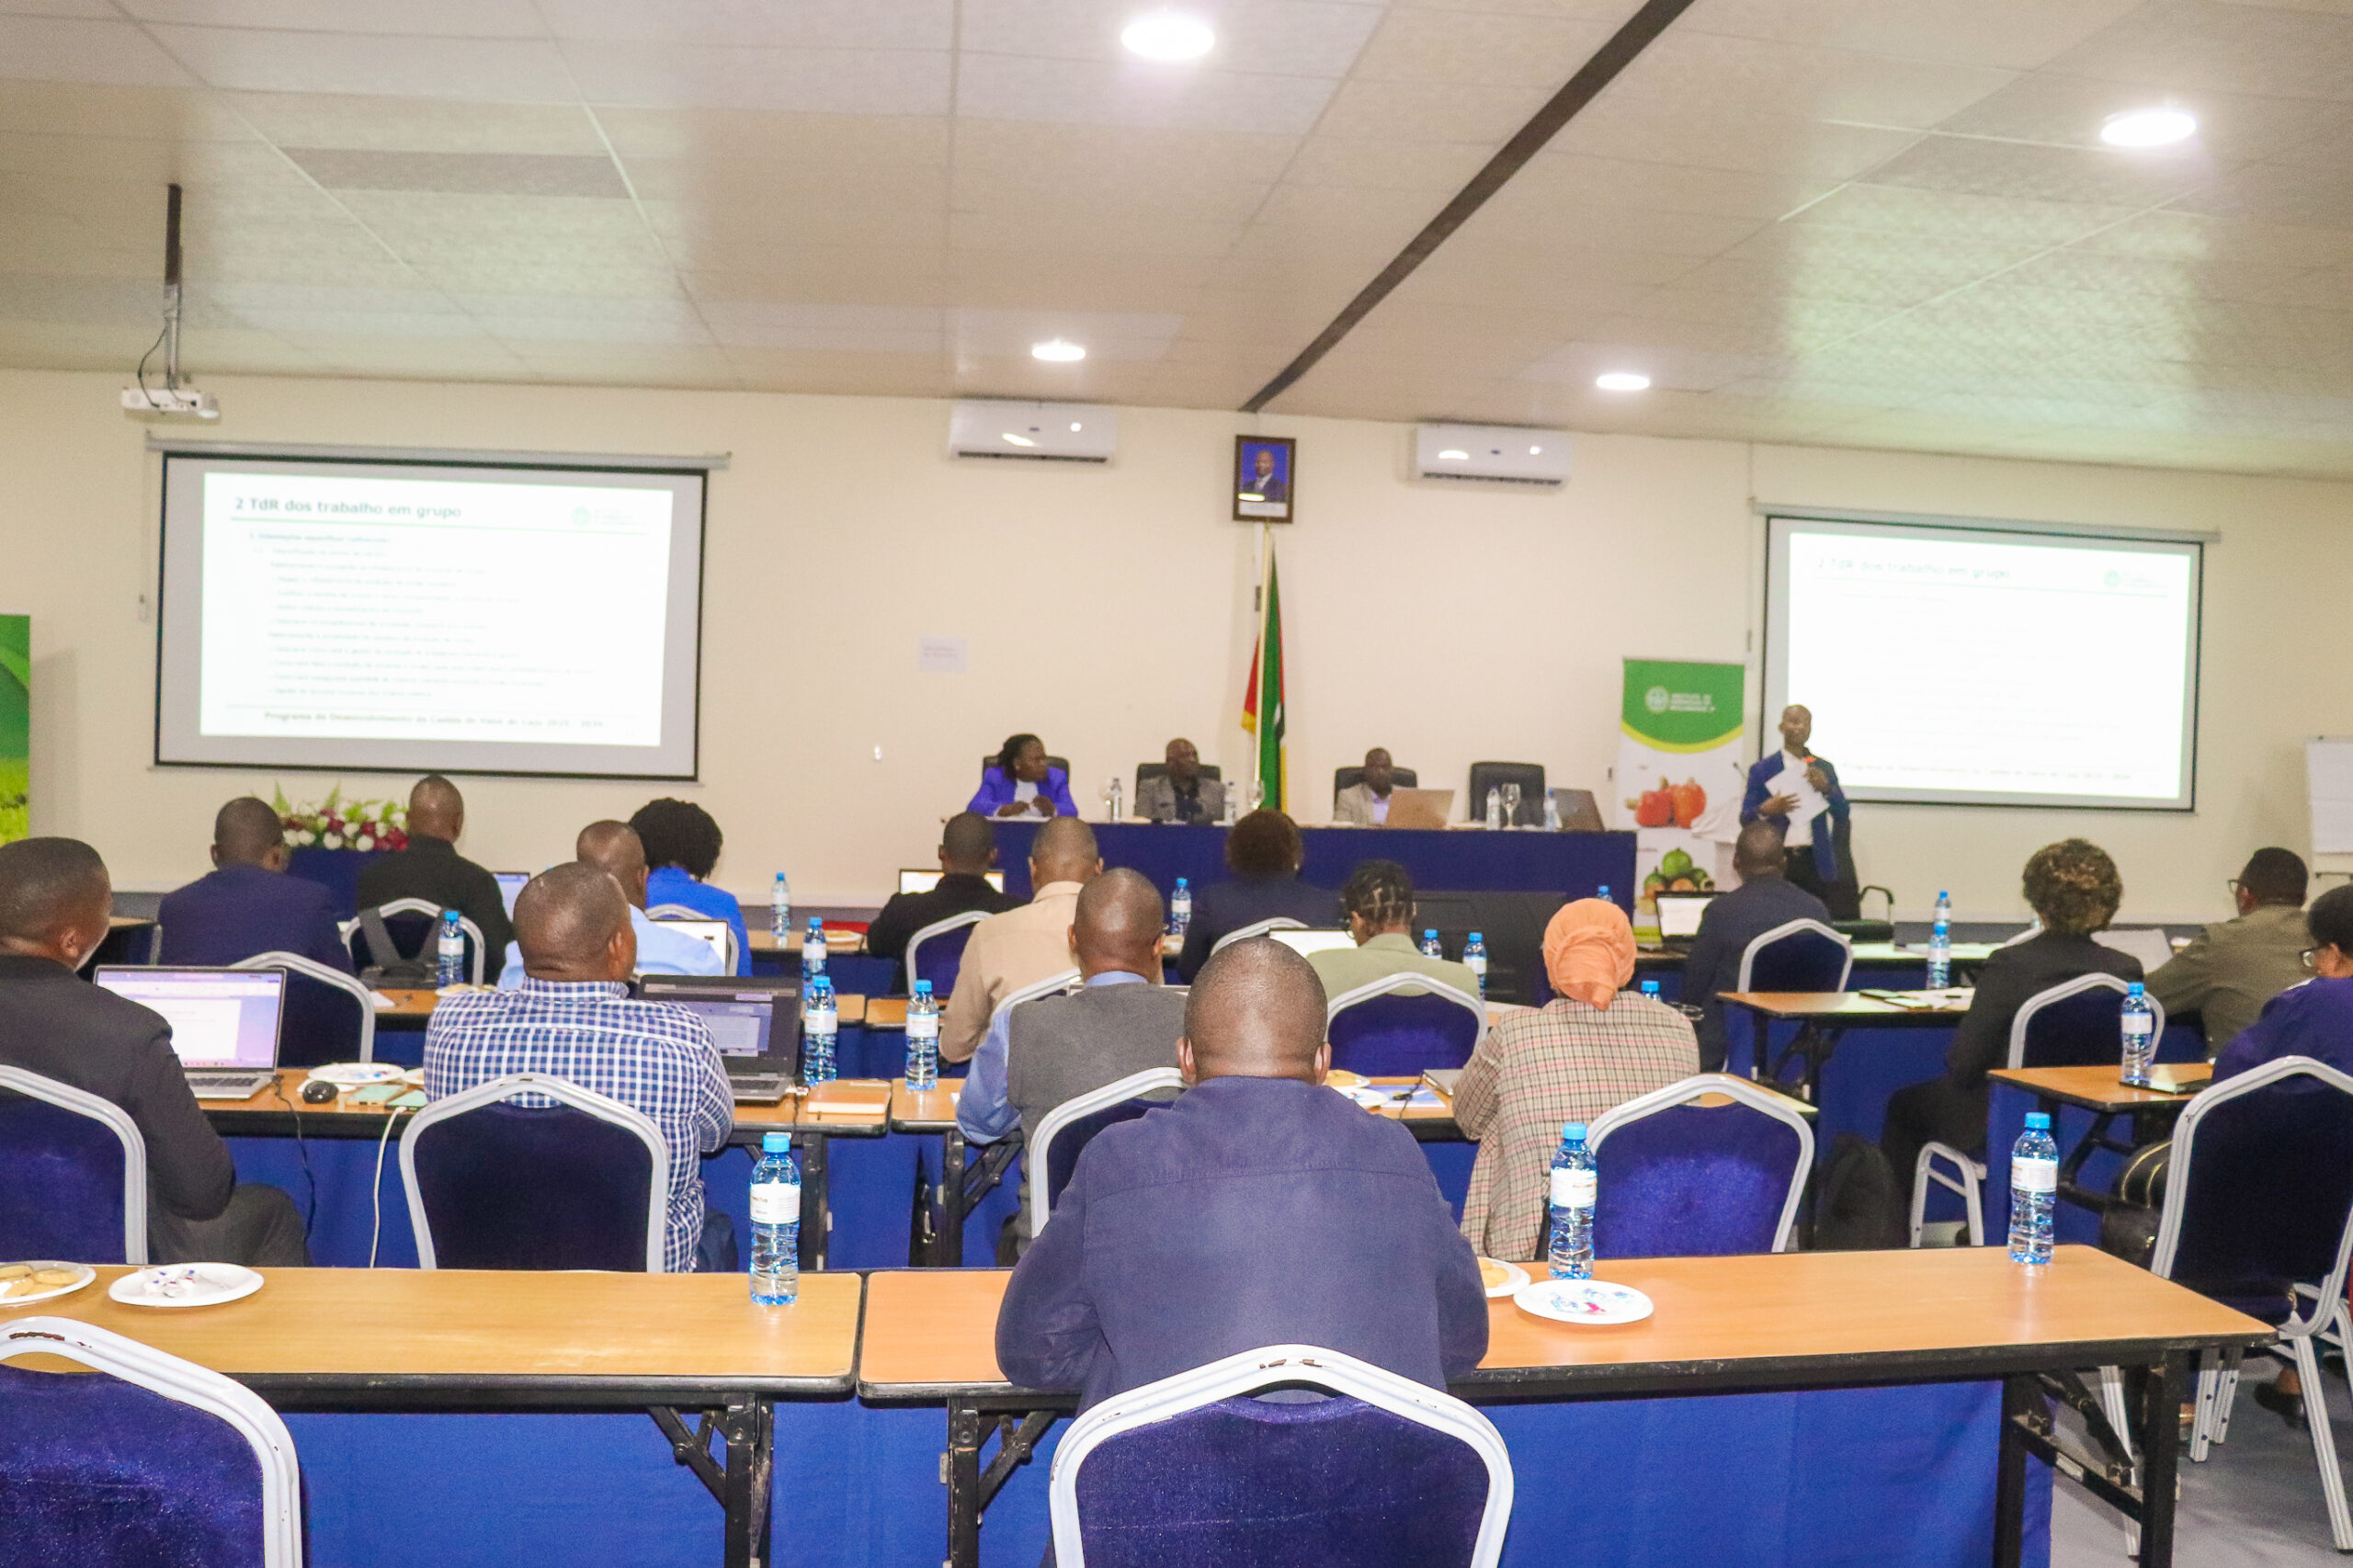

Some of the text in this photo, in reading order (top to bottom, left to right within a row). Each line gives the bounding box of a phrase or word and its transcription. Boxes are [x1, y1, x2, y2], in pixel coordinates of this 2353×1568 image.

[235, 497, 462, 519] 2 TdR dos trabalho em grupo
